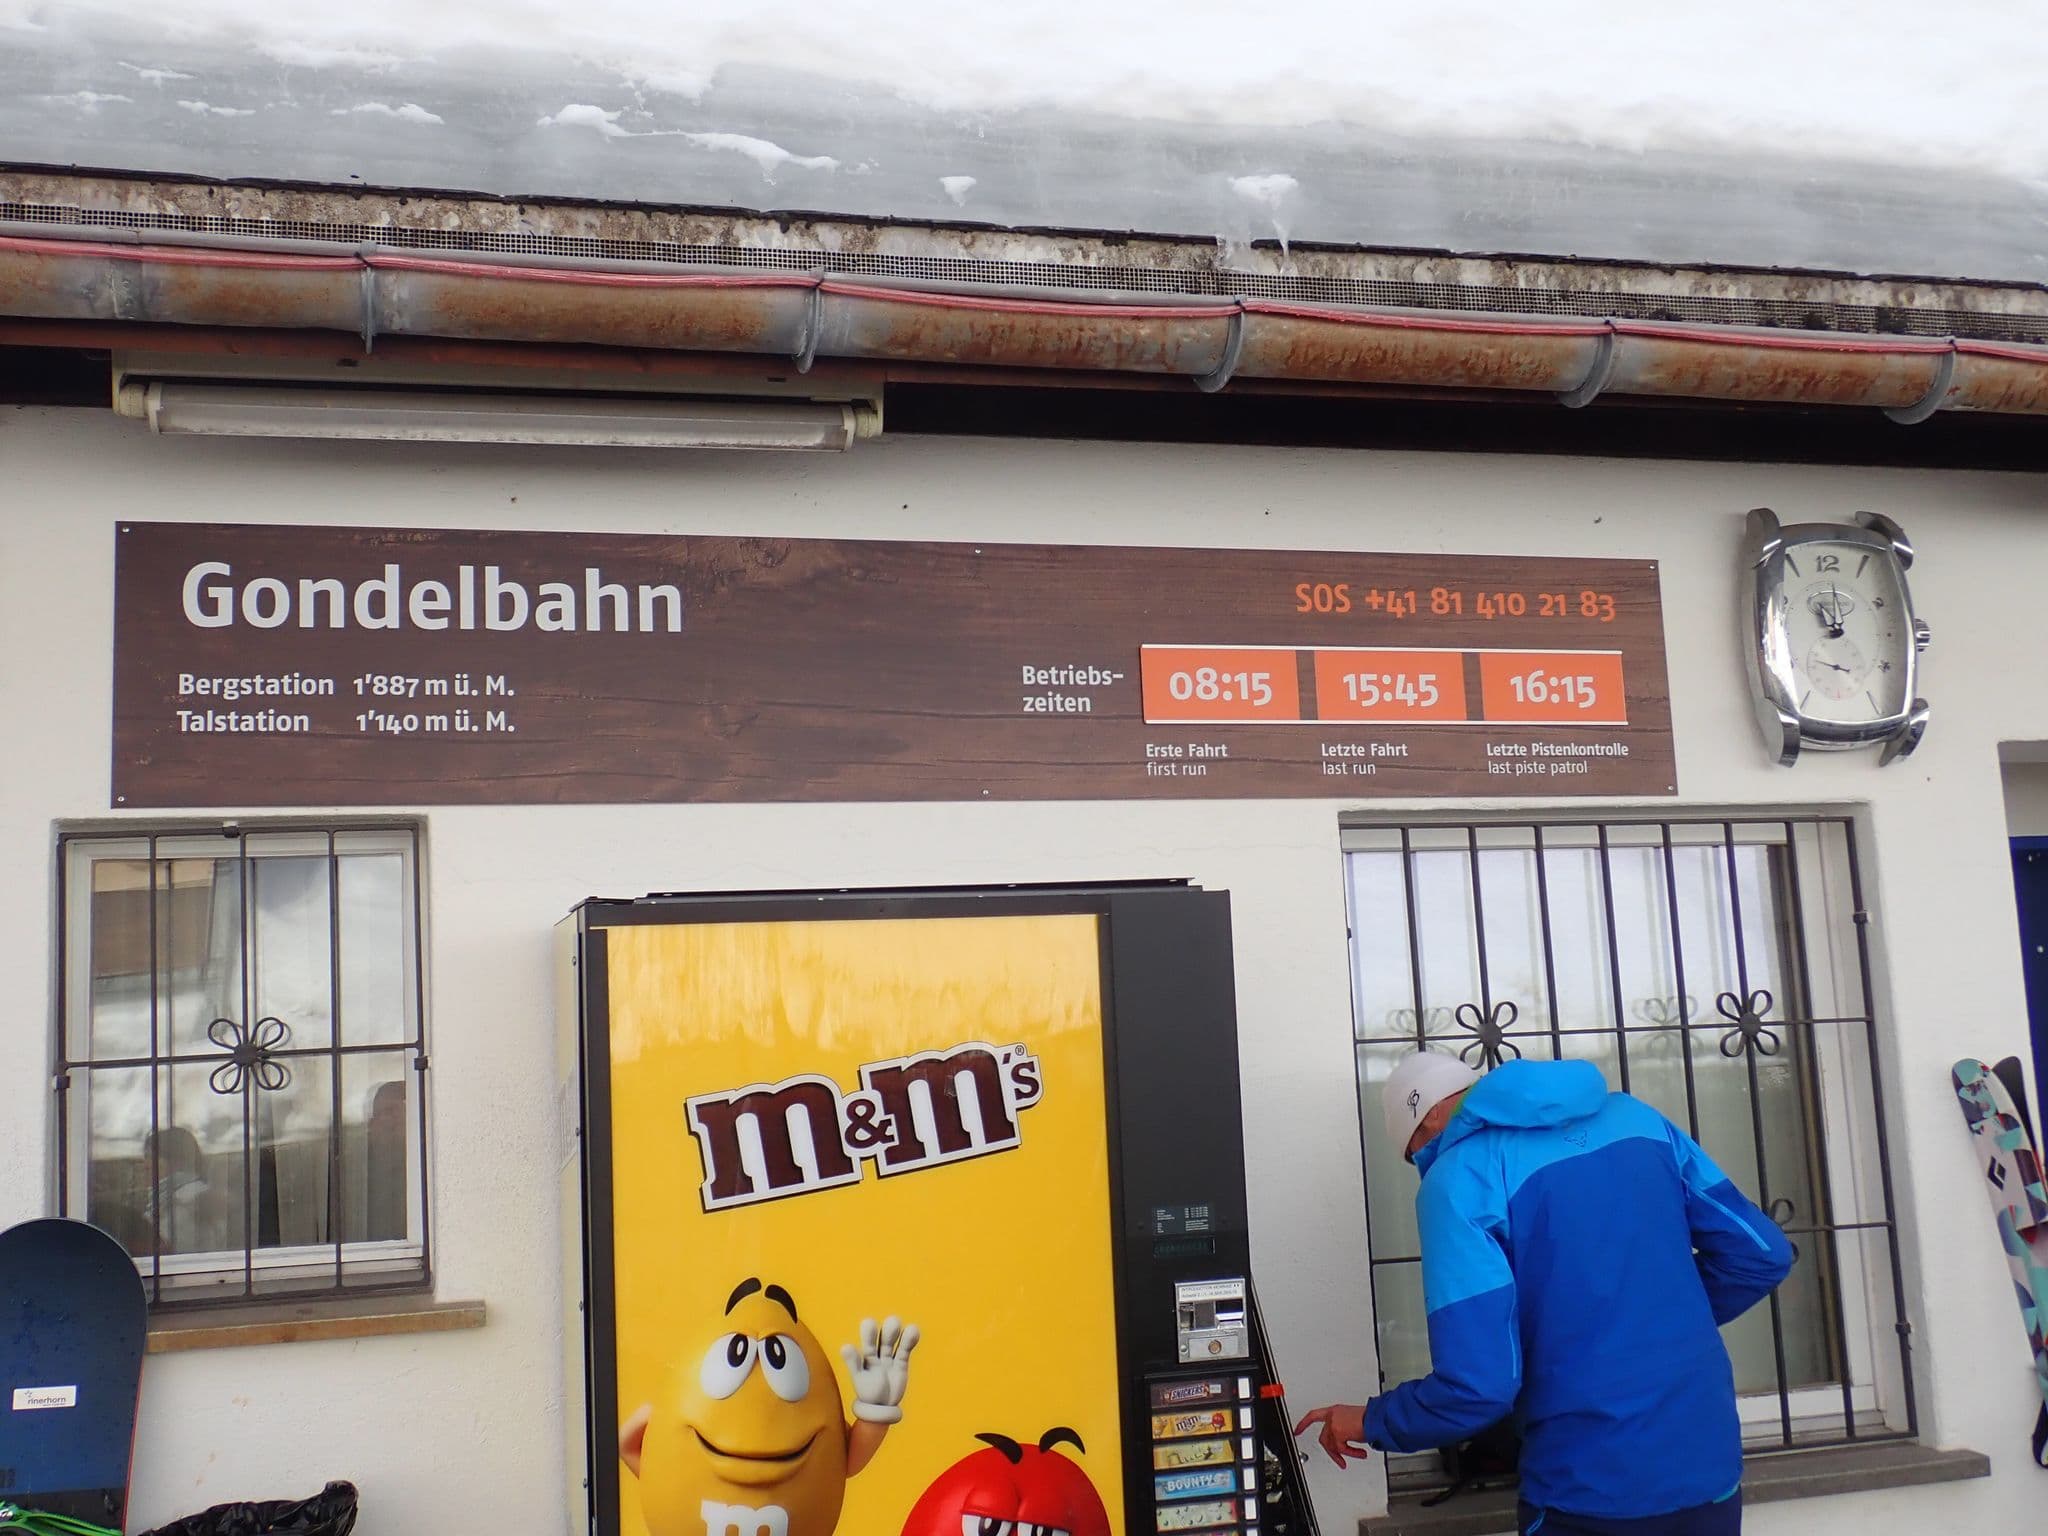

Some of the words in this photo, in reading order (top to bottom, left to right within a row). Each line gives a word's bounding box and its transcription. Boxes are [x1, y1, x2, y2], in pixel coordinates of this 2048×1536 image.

[1815, 554, 1840, 573] 12
[182, 561, 682, 633] Gondelbahn
[1295, 582, 1351, 614] SOS
[1364, 589, 1417, 619] +41
[1430, 586, 1463, 616] 81
[1476, 591, 1527, 620] 410
[1538, 592, 1568, 618] 21
[1579, 589, 1616, 623] 83
[178, 672, 334, 701] Bergstation
[353, 673, 420, 698] 1'887
[424, 679, 448, 696] m
[454, 673, 479, 697] ü.
[485, 674, 515, 697] M.
[1022, 664, 1124, 687] Betriebs-
[1169, 667, 1273, 706] 08:15
[1342, 673, 1439, 707] 15:45
[1510, 670, 1596, 709] 16:15
[1022, 691, 1092, 713] zeiten
[176, 708, 309, 732] Talstation
[356, 709, 419, 735] 1'140
[425, 714, 448, 732] m
[454, 709, 479, 732] ü.
[486, 710, 515, 733] M.
[1145, 743, 1184, 758] Erste
[1188, 742, 1229, 758] Fahrt
[1321, 742, 1366, 757] Letzte
[1370, 742, 1409, 757] Fahrt
[1486, 742, 1528, 757] Letzte
[1531, 742, 1629, 757] Pistenkontrolle
[1145, 761, 1178, 777] first
[1182, 764, 1207, 777] run
[1322, 760, 1349, 775] last
[1352, 763, 1376, 775] run
[1487, 760, 1512, 775] last
[1515, 760, 1546, 777] piste
[1550, 760, 1588, 777] patrol
[1166, 1474, 1214, 1492] BOUNTY
